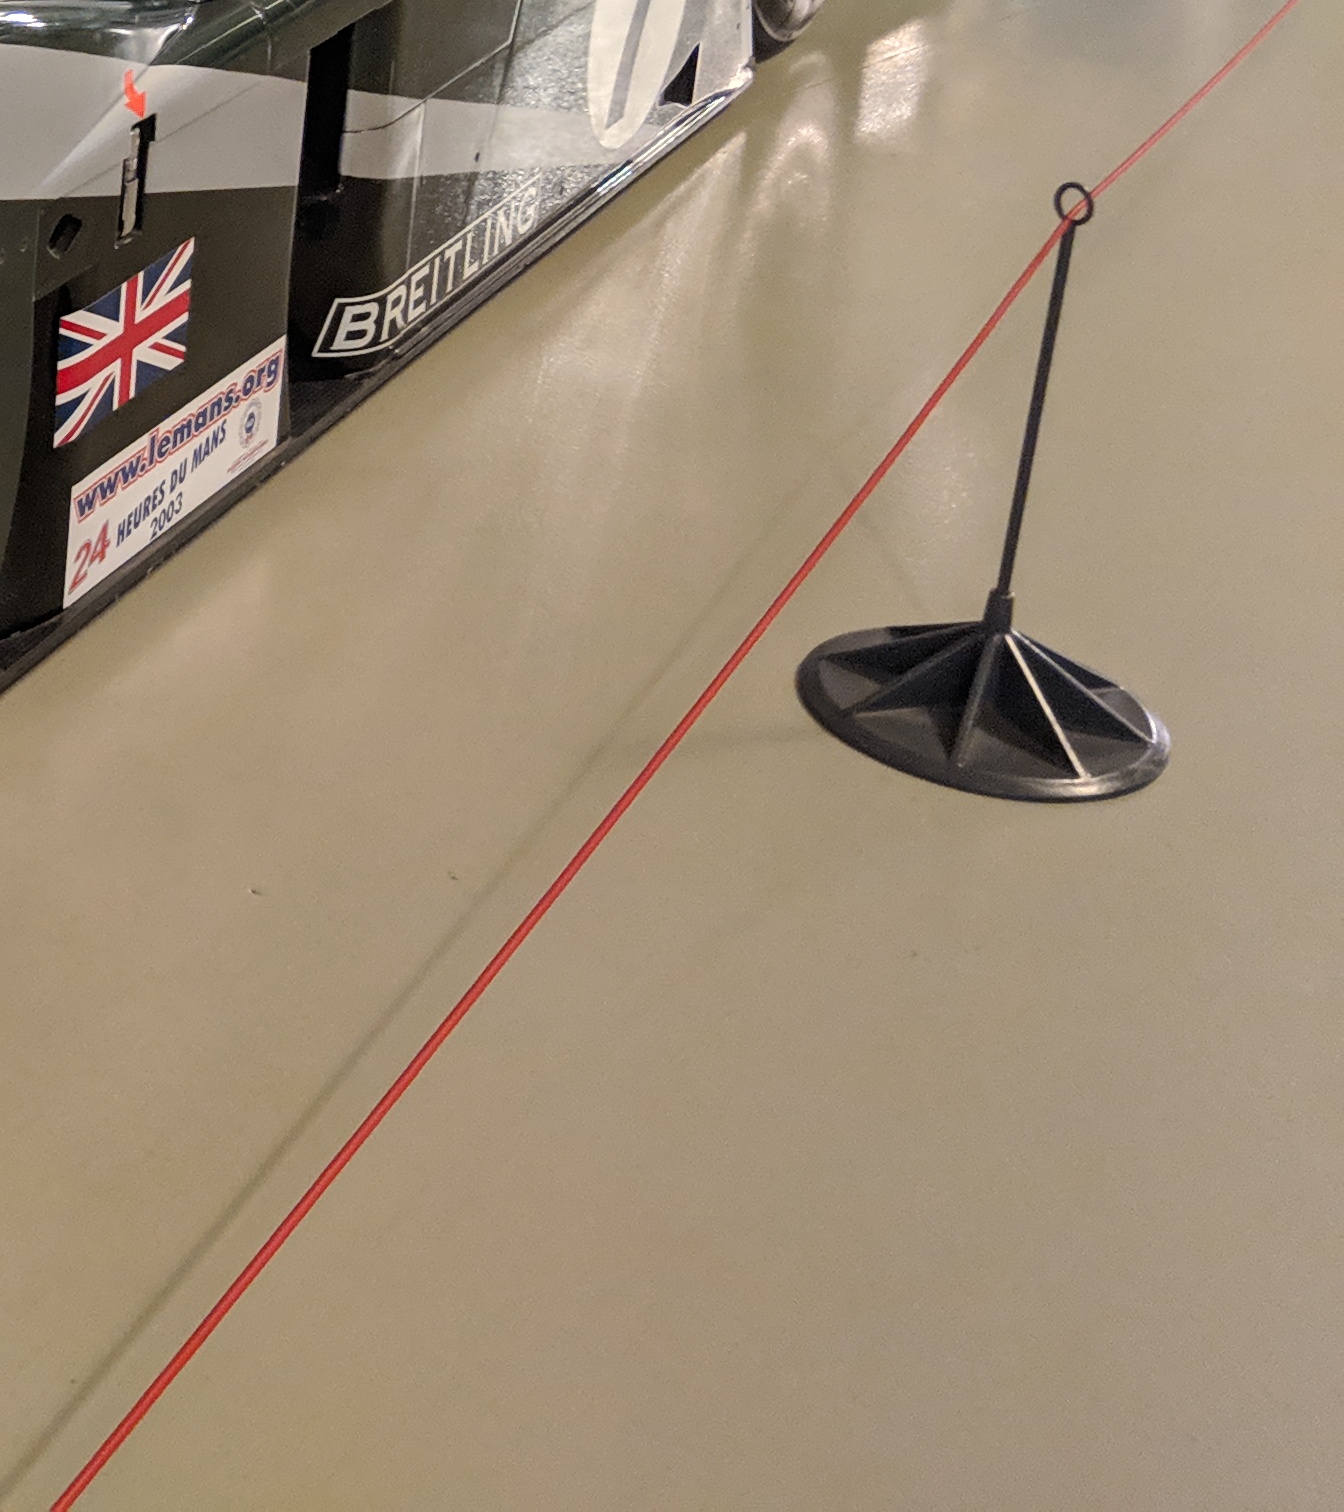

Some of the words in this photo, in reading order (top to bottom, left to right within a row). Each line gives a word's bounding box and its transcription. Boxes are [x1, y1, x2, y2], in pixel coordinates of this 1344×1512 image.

[330, 185, 540, 351] BREITLING
[69, 519, 111, 595] 24
[116, 479, 167, 548] HEURES
[168, 459, 188, 494] DU
[190, 421, 228, 474] MANS
[73, 347, 285, 523] www.lemans.org
[149, 491, 185, 542] 2003
